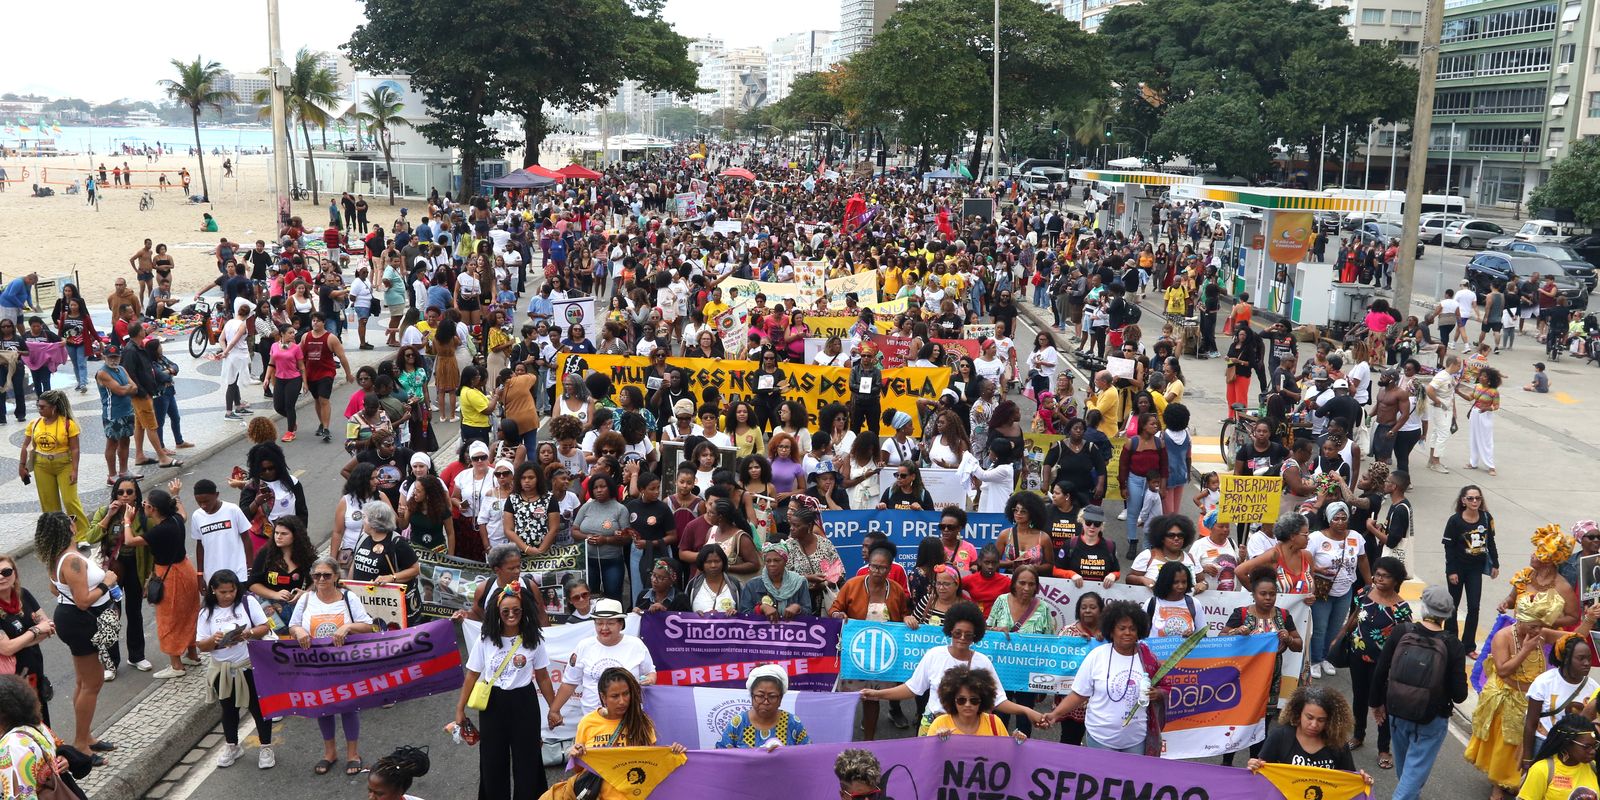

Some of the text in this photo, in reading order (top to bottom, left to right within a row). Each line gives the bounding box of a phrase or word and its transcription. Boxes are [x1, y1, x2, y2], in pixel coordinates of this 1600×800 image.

[826, 328, 847, 338] SUA
[1226, 478, 1281, 492] LIBERDADE
[1246, 494, 1268, 504] MIM
[1232, 504, 1248, 513] NÃO
[1251, 504, 1268, 513] TER
[1232, 513, 1263, 522] MEDO!
[823, 520, 1003, 539] CRP-RJ PRENTE
[414, 549, 438, 562] CHA
[530, 558, 574, 570] NEGRAS
[993, 641, 1086, 656] TRABALHADORES
[997, 655, 1056, 668] MUNICÍPIO
[1061, 660, 1077, 669] DO
[671, 659, 808, 685] PRESETE
[289, 665, 424, 707] PRESENTE
[943, 757, 1011, 792] NÃO
